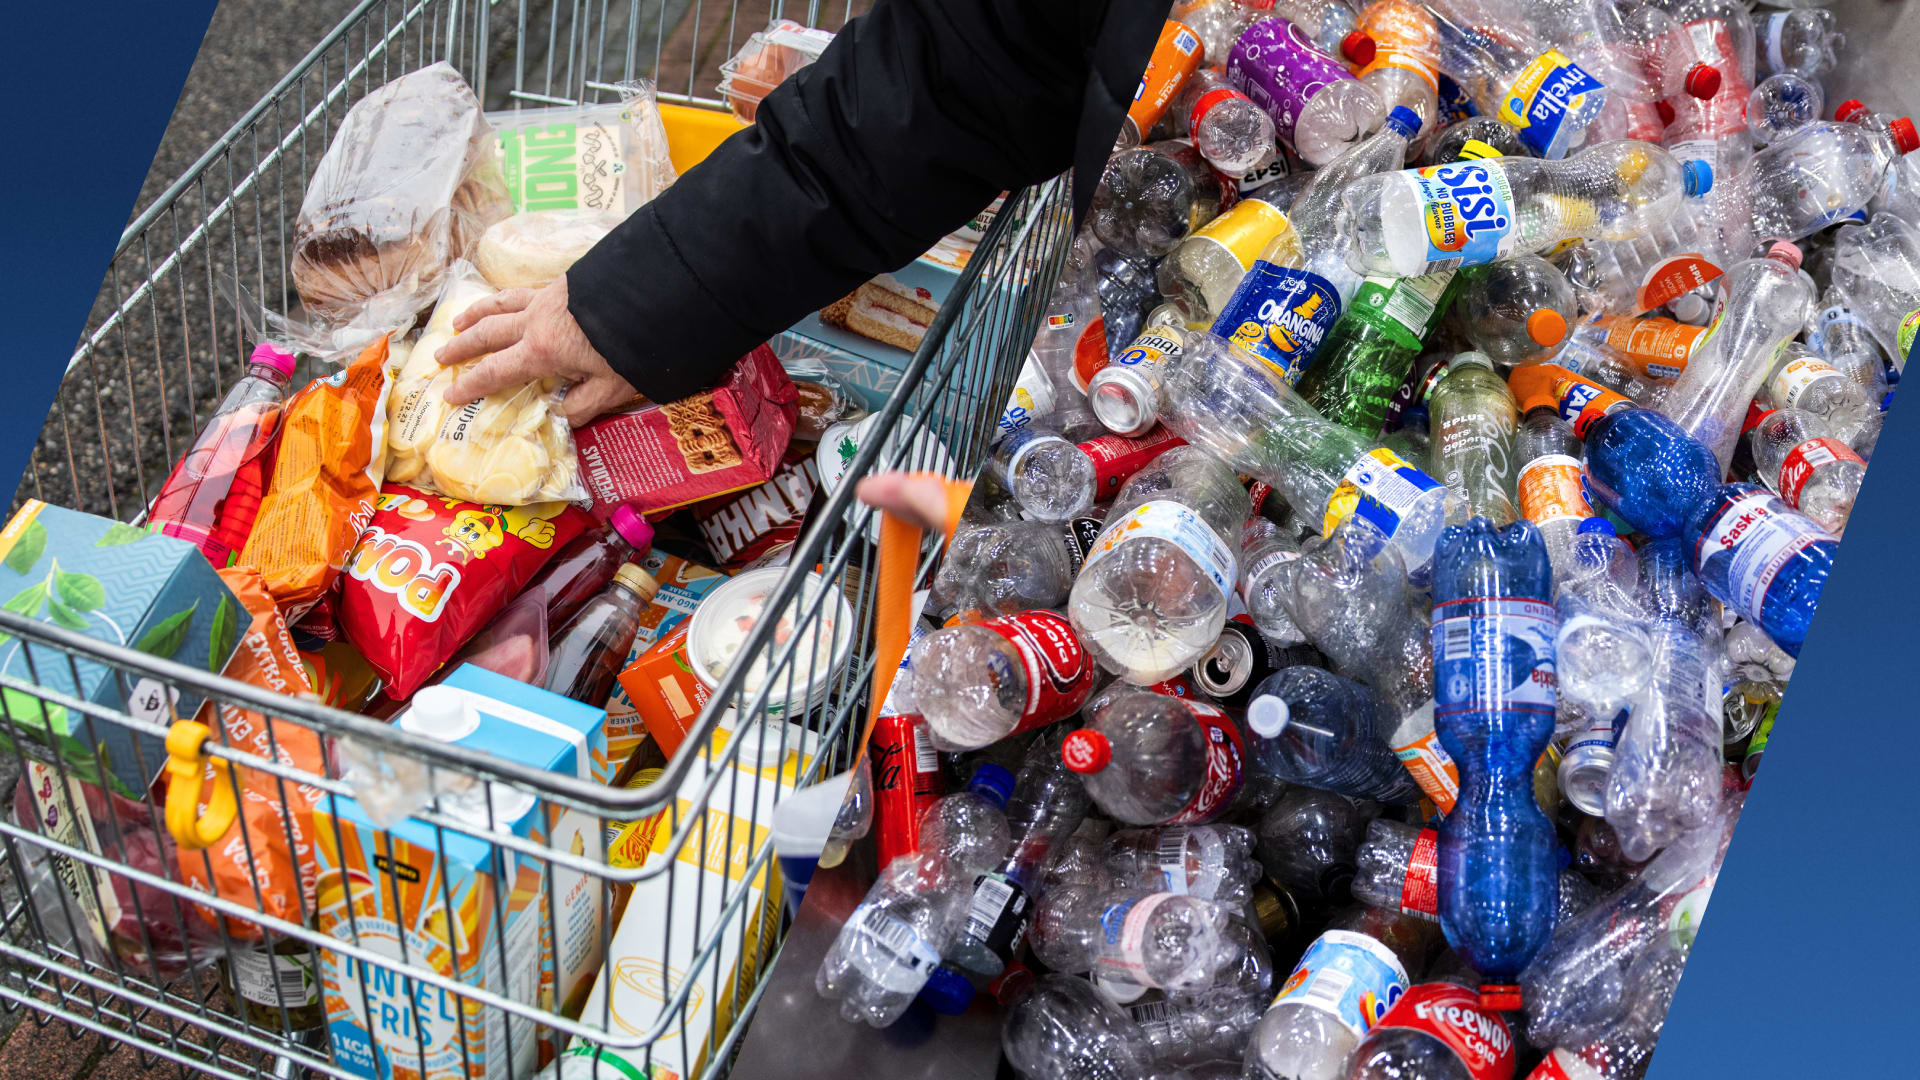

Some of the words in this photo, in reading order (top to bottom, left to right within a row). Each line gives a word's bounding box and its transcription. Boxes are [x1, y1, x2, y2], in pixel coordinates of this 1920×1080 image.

[1532, 67, 1586, 120] rivella
[1436, 187, 1450, 200] NO
[1494, 174, 1513, 203] SUGAR
[1440, 201, 1456, 246] BUBBLES
[1257, 298, 1325, 347] ORANGINA
[1443, 429, 1472, 443] Vers
[1451, 413, 1486, 427] PLUS
[582, 445, 620, 504] SPECULAAS
[245, 631, 287, 692] EXTRA
[1031, 618, 1070, 665] Cola
[1414, 999, 1511, 1058] Freeway
[1464, 1034, 1497, 1066] Cola
